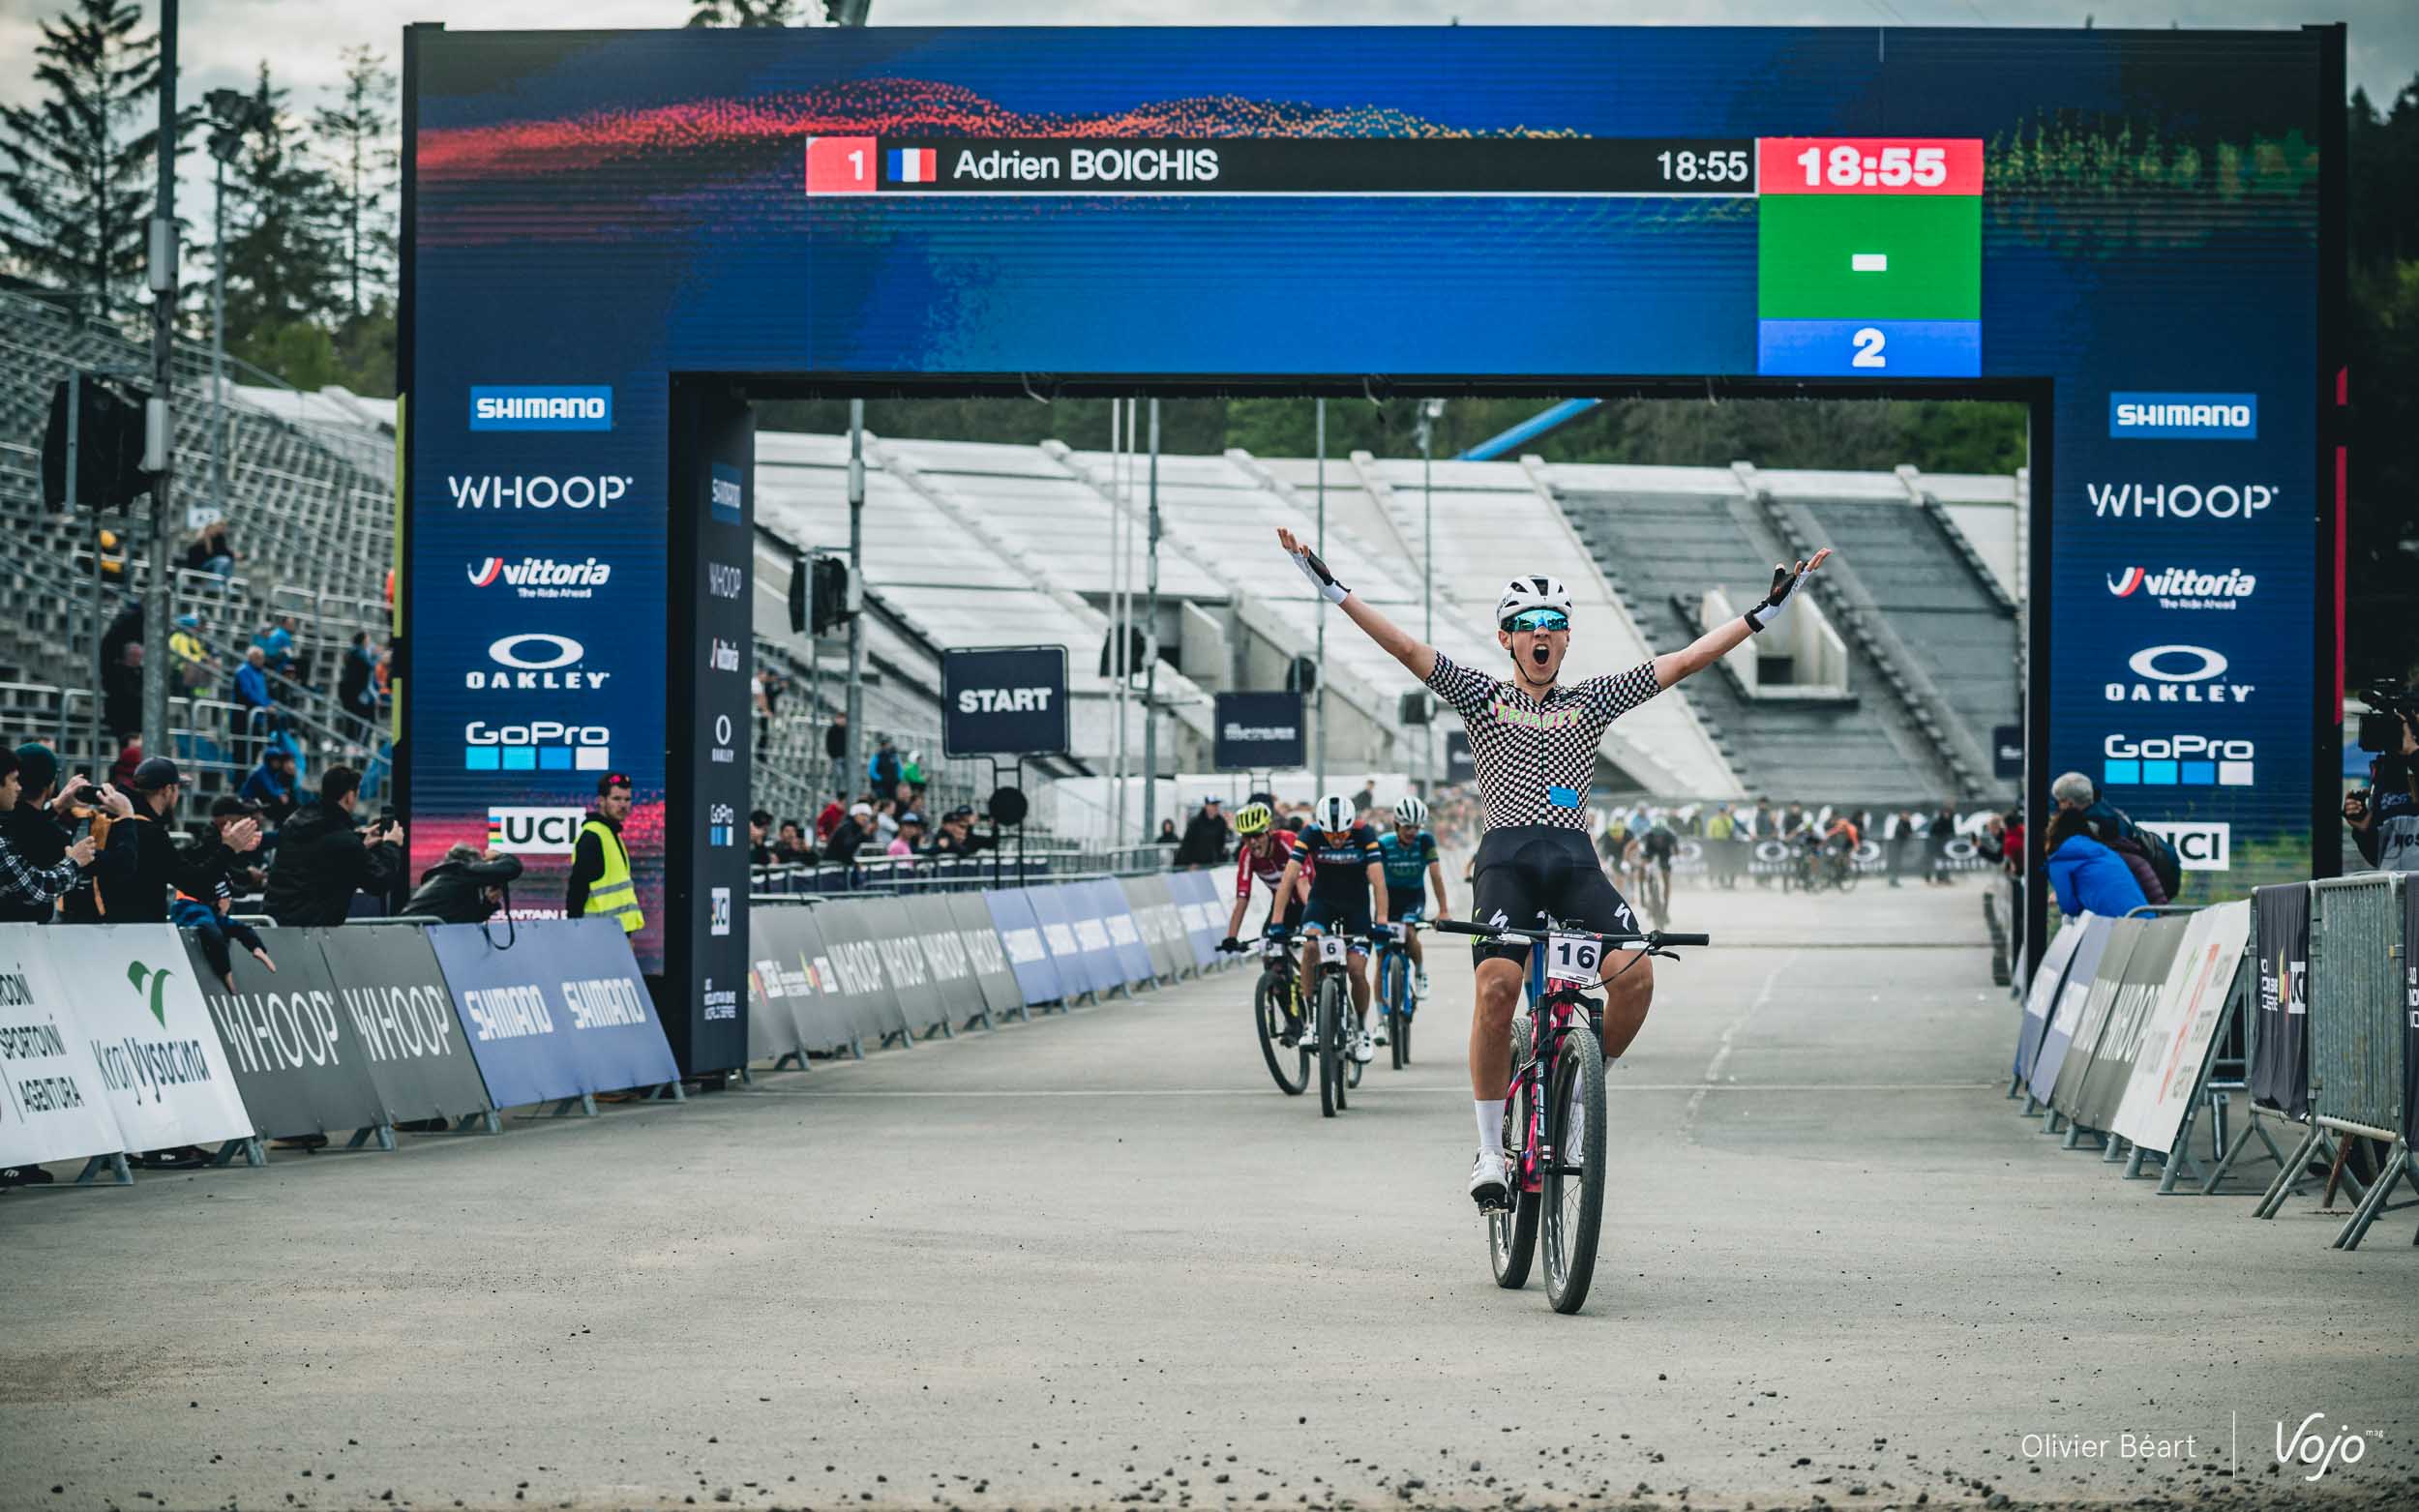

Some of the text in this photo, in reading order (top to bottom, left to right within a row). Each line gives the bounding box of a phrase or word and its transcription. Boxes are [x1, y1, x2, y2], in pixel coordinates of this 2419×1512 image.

[848, 148, 1748, 182] 1 Adrien BOICHIS 18:55
[1798, 146, 1947, 187] 18:55
[1852, 328, 1887, 368] 2
[476, 398, 606, 419] SHIMANO
[2116, 404, 2251, 427] SHIMANO
[448, 475, 627, 509] WHOOP
[2087, 483, 2274, 519] WHOOP
[502, 557, 612, 585] vittoria
[2143, 567, 2257, 597] vittoria
[465, 671, 608, 690] OAKLEY
[2105, 683, 2251, 702] OAKLEY
[958, 687, 1053, 714] START
[465, 721, 610, 745] GoPro
[2105, 733, 2255, 759] GoPro
[506, 816, 577, 845] UCI
[2166, 832, 2221, 861] CI
[1327, 942, 1336, 955] 6
[1557, 942, 1597, 969] 16
[464, 984, 554, 1041] SHIMANO
[560, 977, 646, 1030] SHIMANO
[0, 1014, 67, 1060] SPORTOVNÍ
[210, 990, 339, 1074] WHOOP
[343, 985, 451, 1062] WHOOP
[90, 1039, 142, 1107] Kraj
[17, 1075, 85, 1114] AGENTURA
